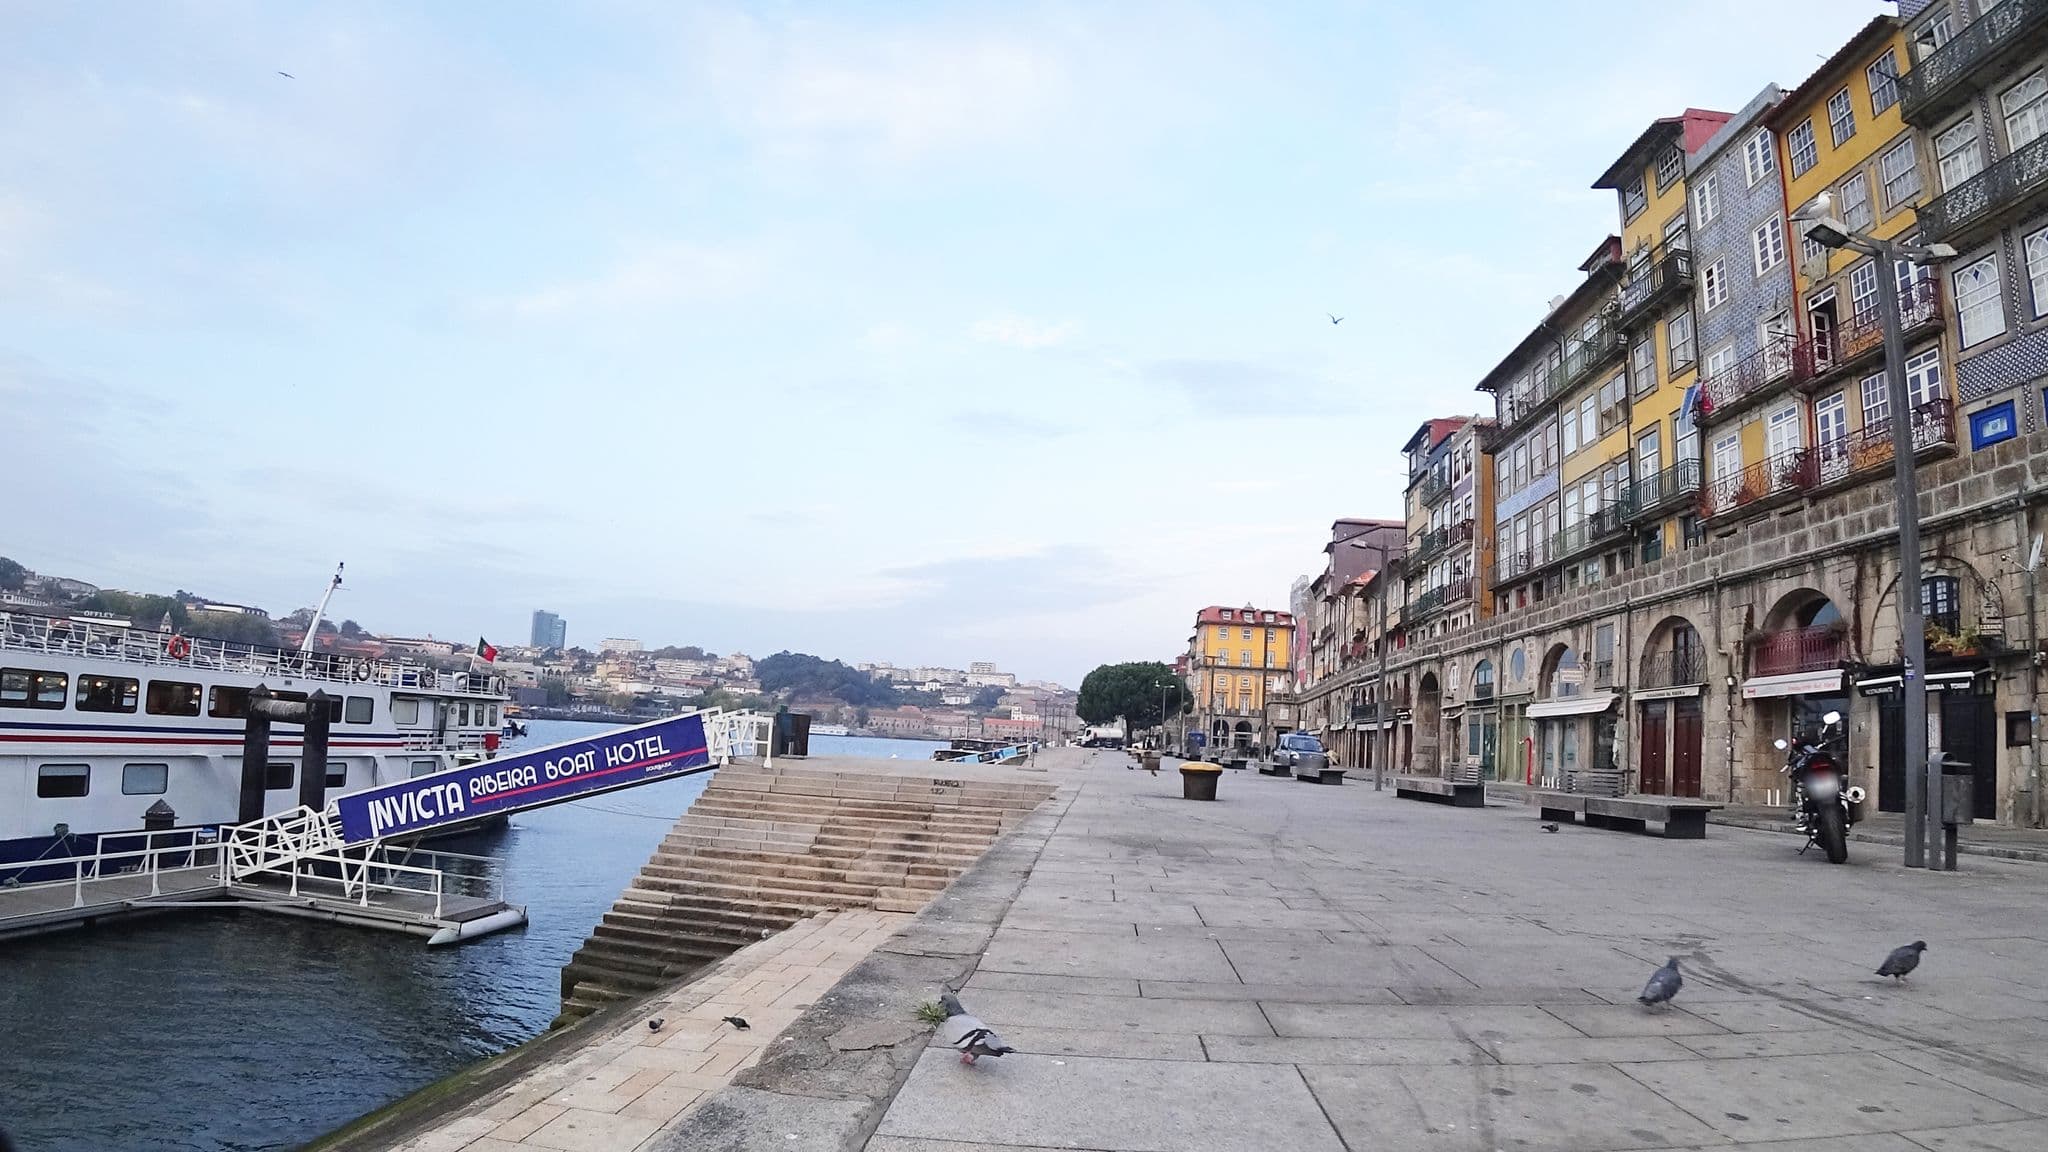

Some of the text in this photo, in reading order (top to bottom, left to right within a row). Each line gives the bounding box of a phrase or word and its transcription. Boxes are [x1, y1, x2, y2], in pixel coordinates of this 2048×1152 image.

[83, 610, 115, 619] OFFLEY
[368, 735, 670, 838] INVICTA RIBEIRA BOAT HOTEL
